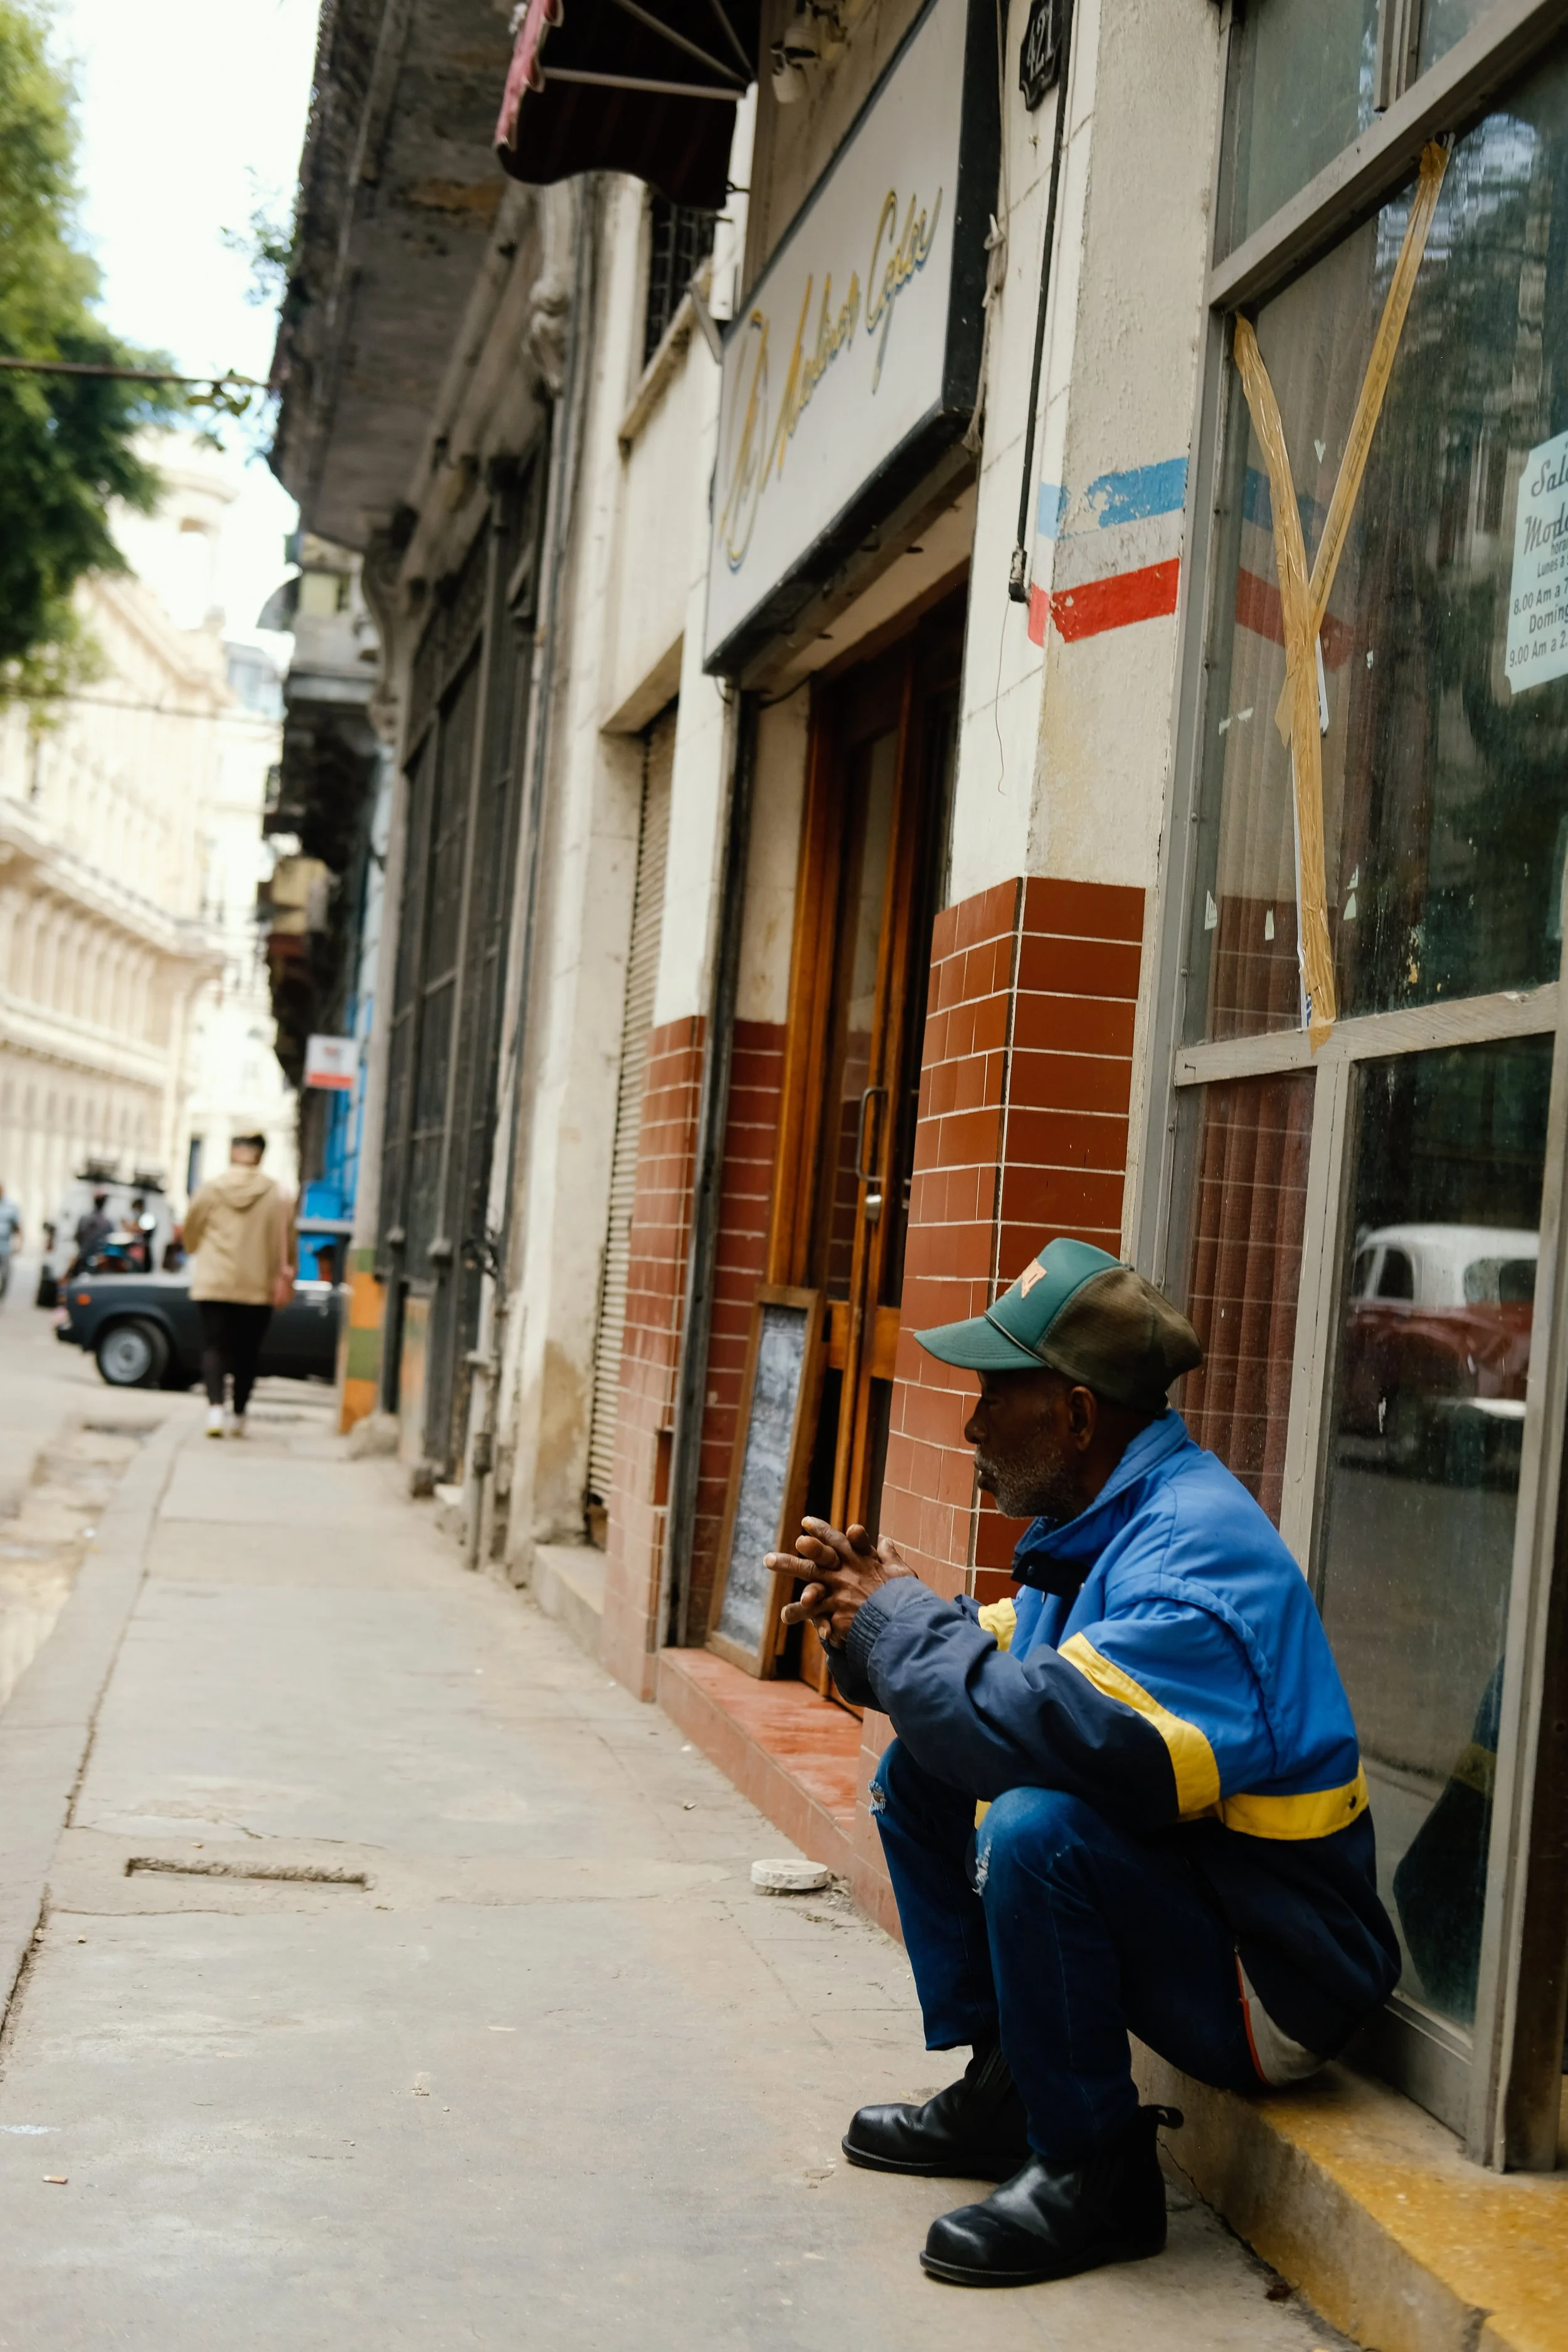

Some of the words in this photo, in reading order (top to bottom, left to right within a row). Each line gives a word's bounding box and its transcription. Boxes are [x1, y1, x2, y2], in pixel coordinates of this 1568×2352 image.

[1026, 0, 1054, 82] 421
[1513, 591, 1534, 616] 8.00
[1535, 588, 1551, 607] Am
[1555, 584, 1561, 598] a
[1509, 643, 1529, 668] 9.00
[1531, 640, 1547, 660] Am
[1550, 638, 1557, 653] a
